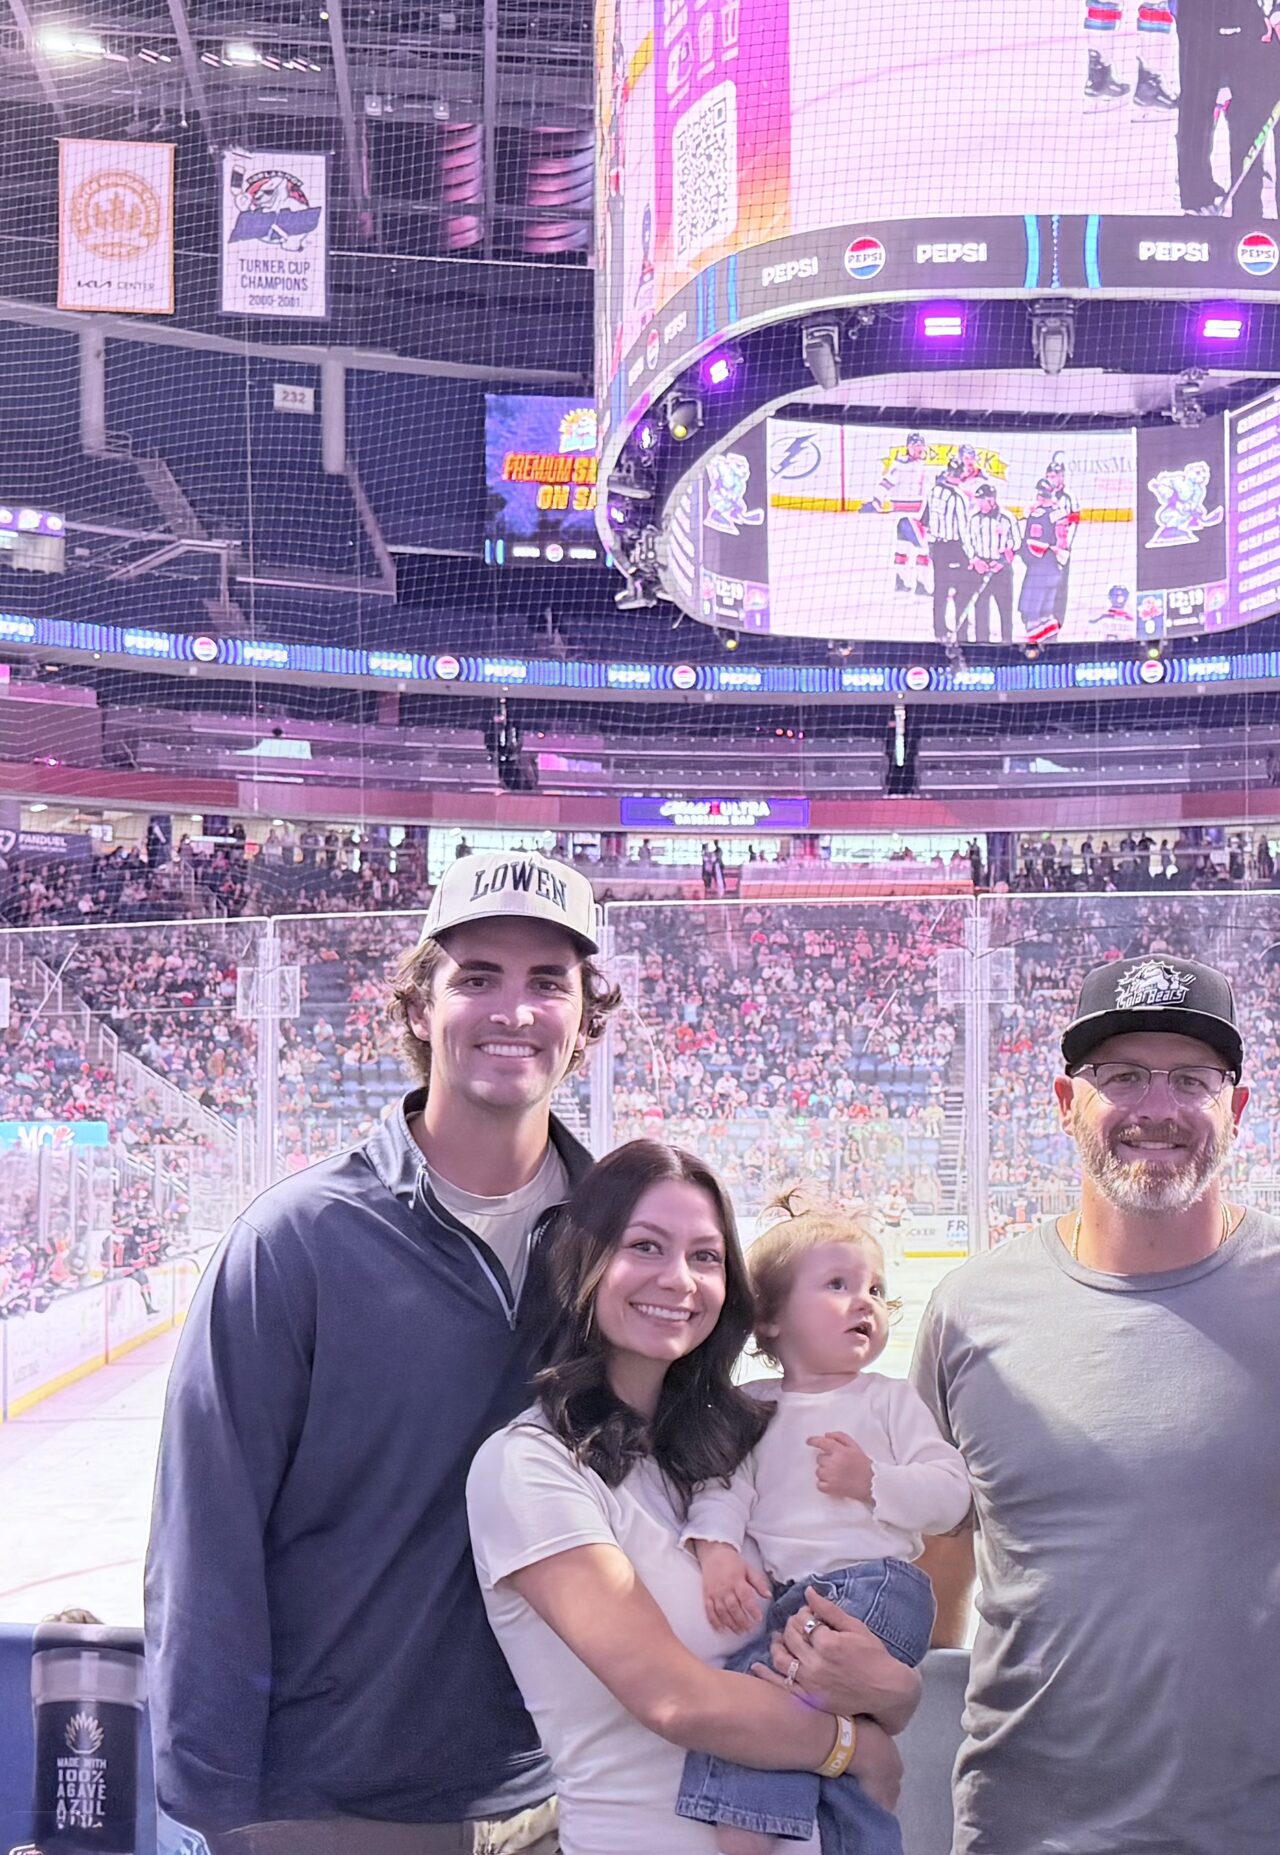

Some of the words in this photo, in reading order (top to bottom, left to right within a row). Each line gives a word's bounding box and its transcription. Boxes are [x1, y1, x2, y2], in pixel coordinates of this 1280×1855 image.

[1139, 241, 1209, 262] PEPSI
[1241, 247, 1278, 260] PEPSI
[239, 258, 286, 274] TURNER
[288, 260, 311, 275] CUP
[762, 257, 819, 287] PEPSI
[847, 251, 883, 264] PEPSI
[916, 242, 988, 264] PEPSI
[240, 277, 309, 292] CHAMPIONS
[280, 388, 307, 406] 232
[19, 833, 68, 847] FANDUEL
[469, 859, 568, 912] LOWEN
[57, 1757, 79, 1768] MADE
[83, 1758, 107, 1770] WITH
[58, 1769, 105, 1783] 100%
[57, 1783, 106, 1799] AGAVE
[57, 1799, 105, 1816] AZUL
